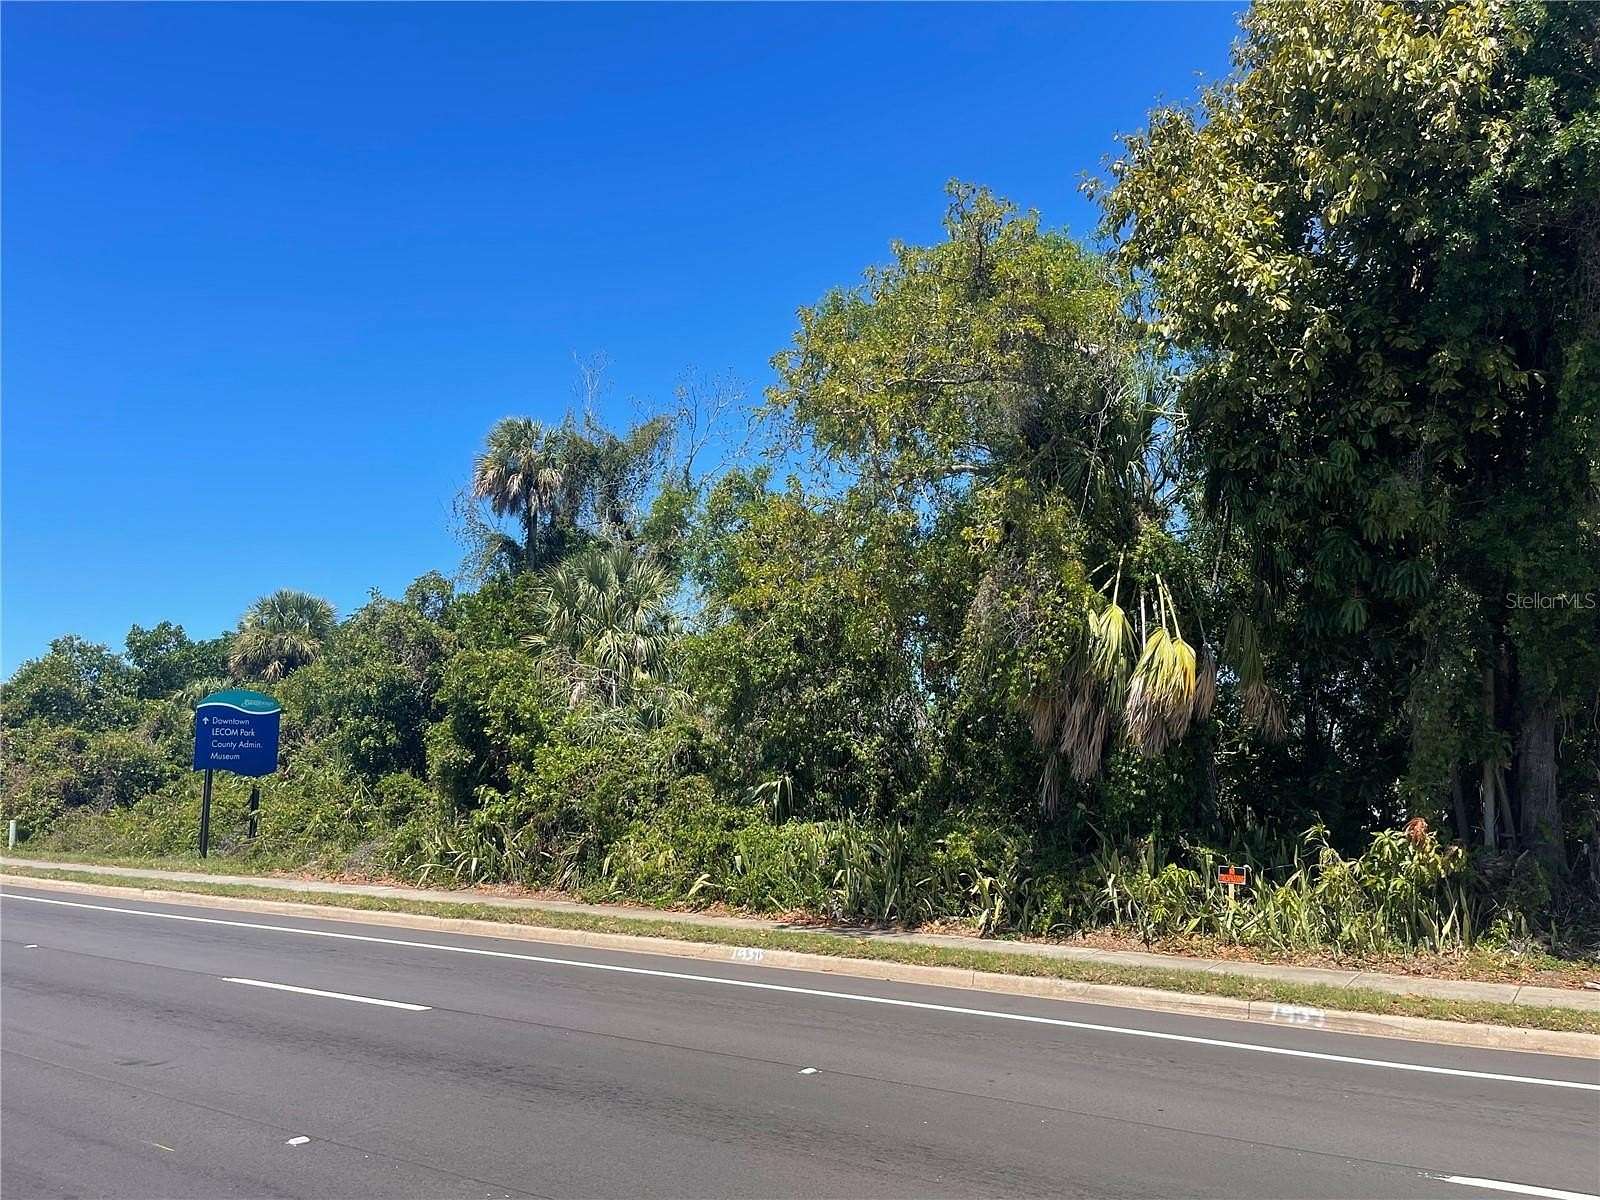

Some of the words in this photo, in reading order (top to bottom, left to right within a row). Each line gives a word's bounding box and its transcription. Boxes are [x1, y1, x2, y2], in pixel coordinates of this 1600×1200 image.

[212, 716, 250, 725] Downtown
[211, 728, 238, 736] LECOM
[239, 728, 256, 737] Park
[211, 740, 237, 750] County
[238, 740, 263, 749] Admin.
[210, 752, 240, 760] Museum
